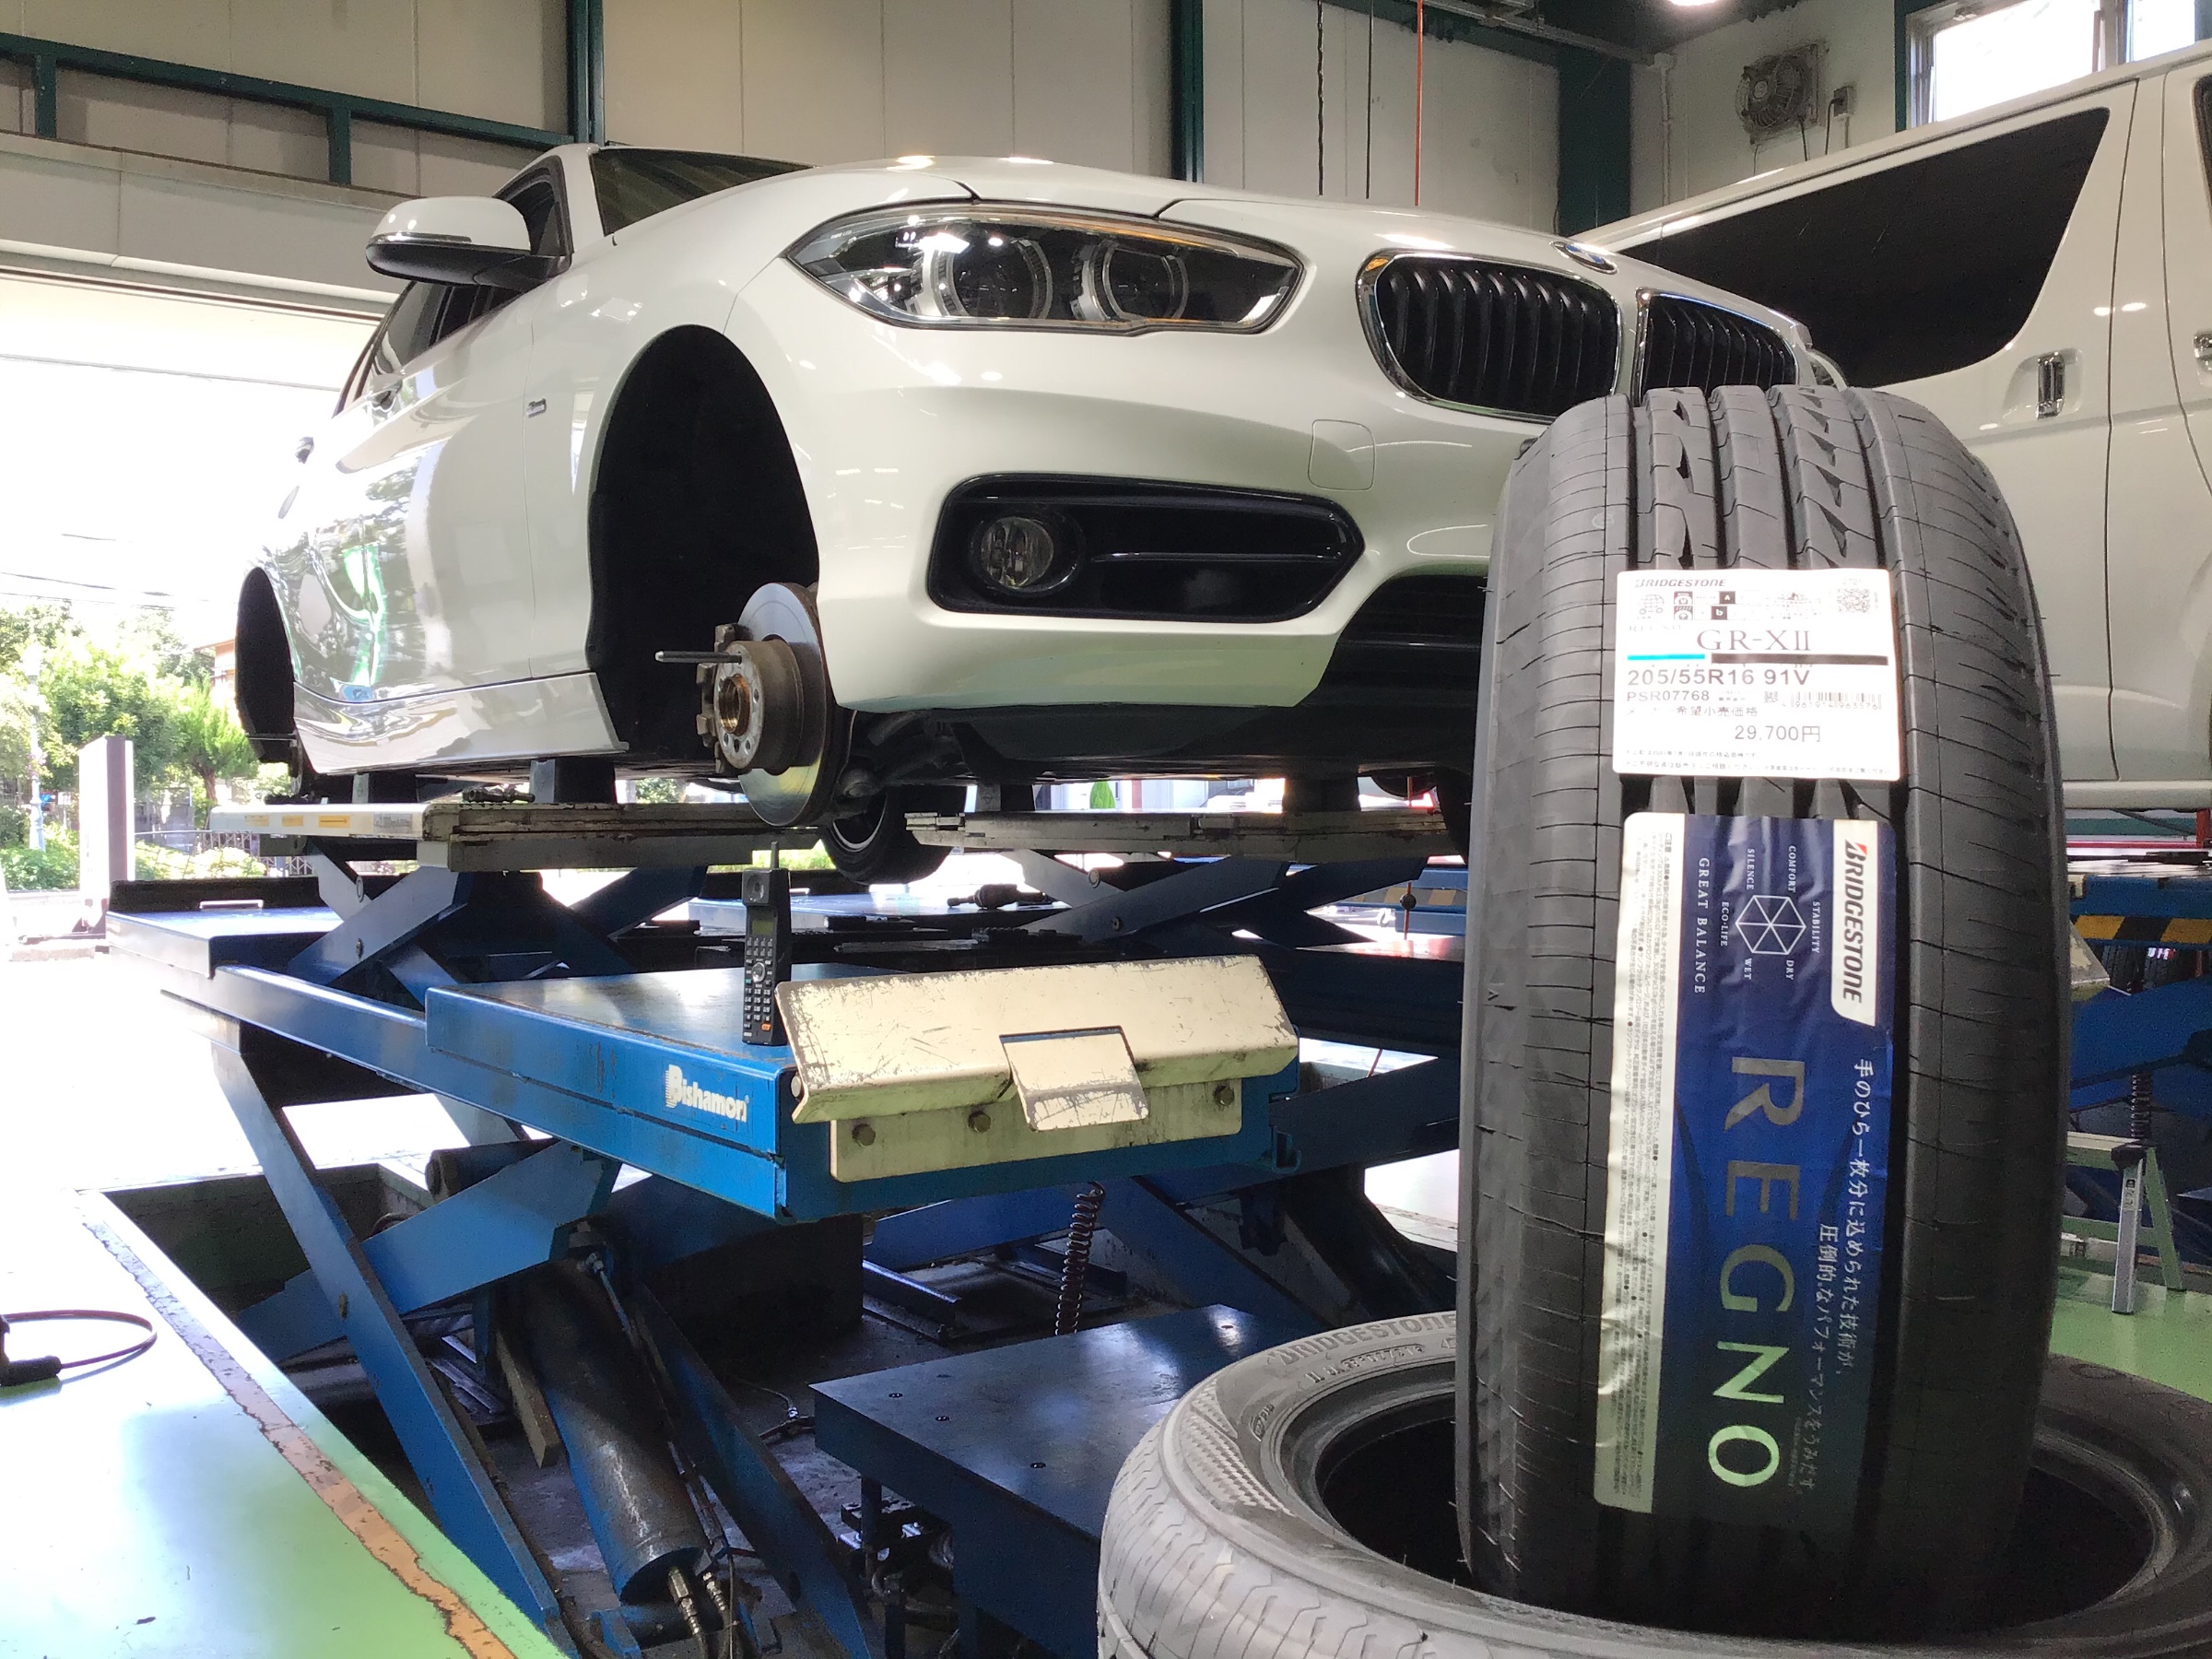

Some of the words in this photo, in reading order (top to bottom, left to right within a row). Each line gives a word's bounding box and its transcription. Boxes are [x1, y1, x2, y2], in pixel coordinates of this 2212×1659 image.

[1635, 578, 1726, 588] BRIDGESTONE
[1627, 690, 1711, 702] PSR07768
[1628, 669, 1755, 686] 205/55R16
[1764, 669, 1810, 686] 91V
[1735, 724, 1821, 743] 29,700円
[1697, 856, 1711, 910] GREAT
[1746, 848, 1756, 890] SILENCE
[1788, 844, 1797, 893] COMFORT
[1811, 900, 1821, 954] STABILITY
[1843, 840, 1868, 1004] BRIDGESTONE
[1694, 917, 1708, 994] BALANCE
[1743, 958, 1752, 980] WET
[1785, 959, 1795, 981] DRY
[1708, 1057, 1806, 1488] REGNO
